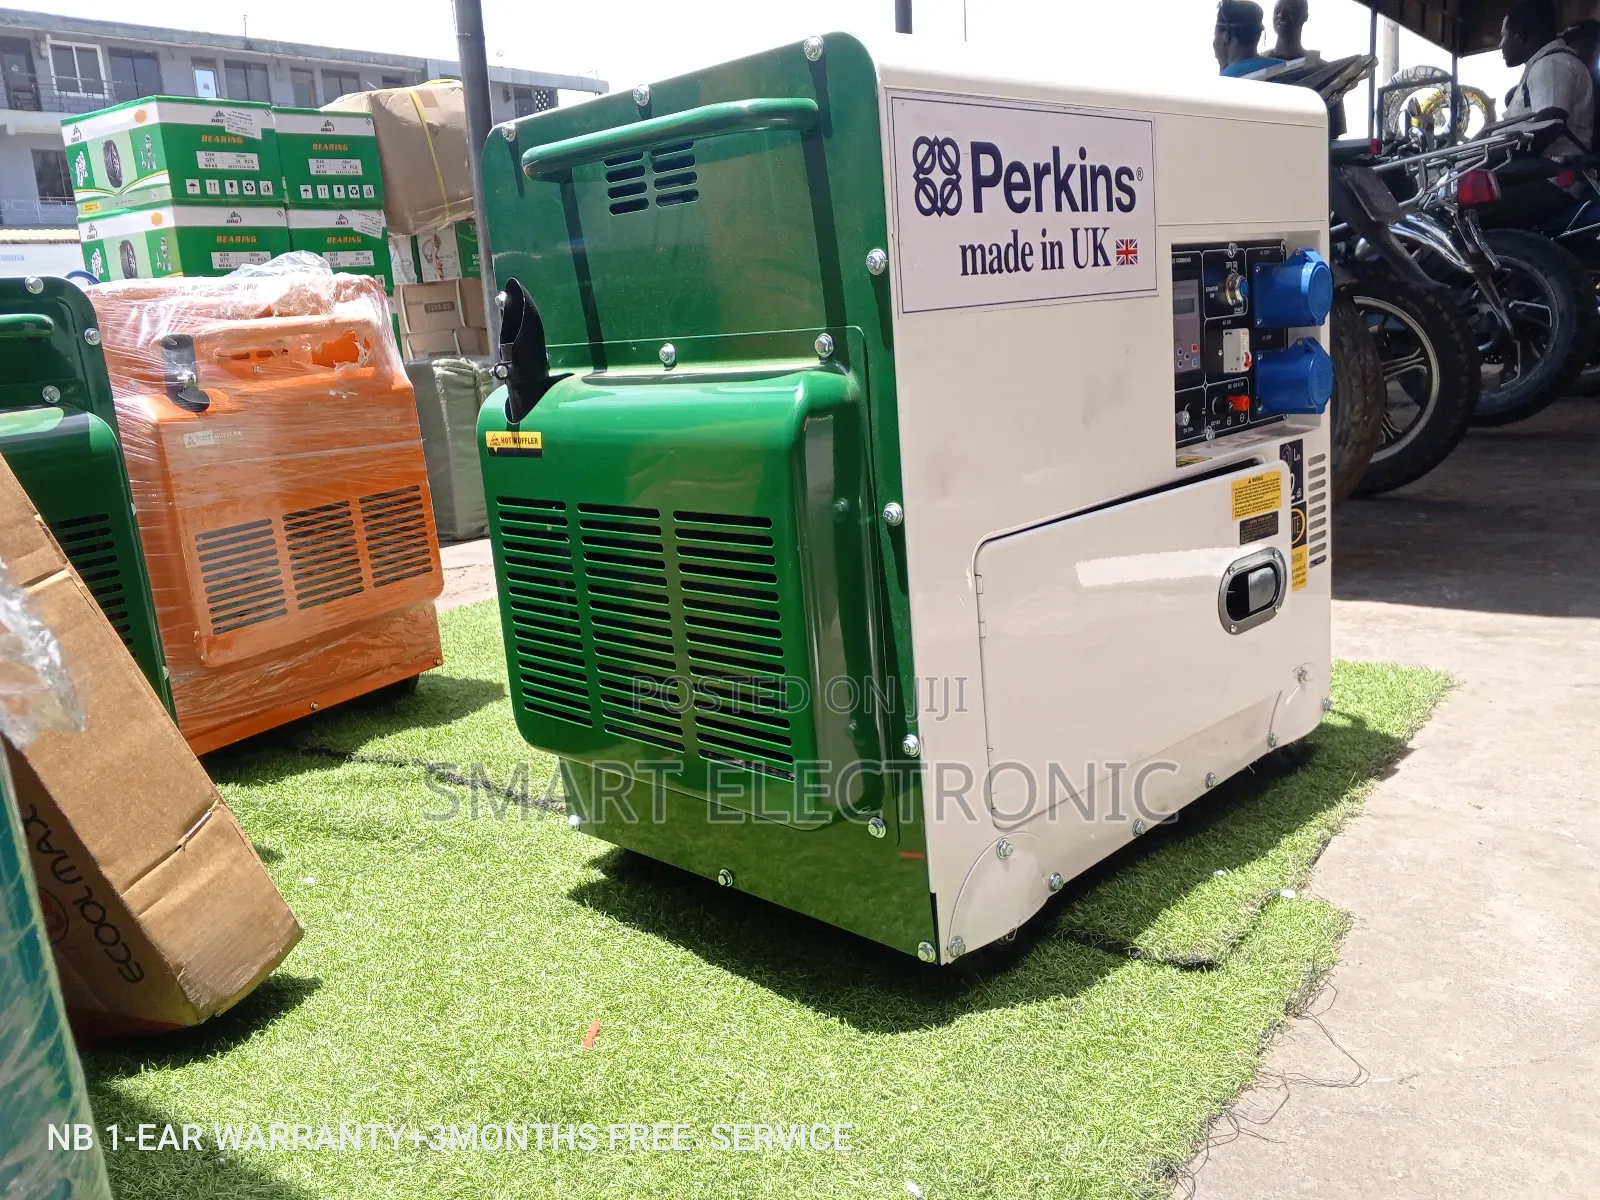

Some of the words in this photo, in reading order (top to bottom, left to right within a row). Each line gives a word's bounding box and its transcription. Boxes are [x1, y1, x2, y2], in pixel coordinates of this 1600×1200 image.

[201, 135, 243, 144] BEARING
[312, 143, 349, 151] BEARING
[216, 235, 257, 243] BEARING
[326, 236, 362, 244] BEARING
[959, 229, 1034, 276] made
[1040, 227, 1064, 270] in
[1070, 226, 1111, 269] UK
[196, 433, 211, 442] HOT
[513, 436, 538, 445] MUFFLER
